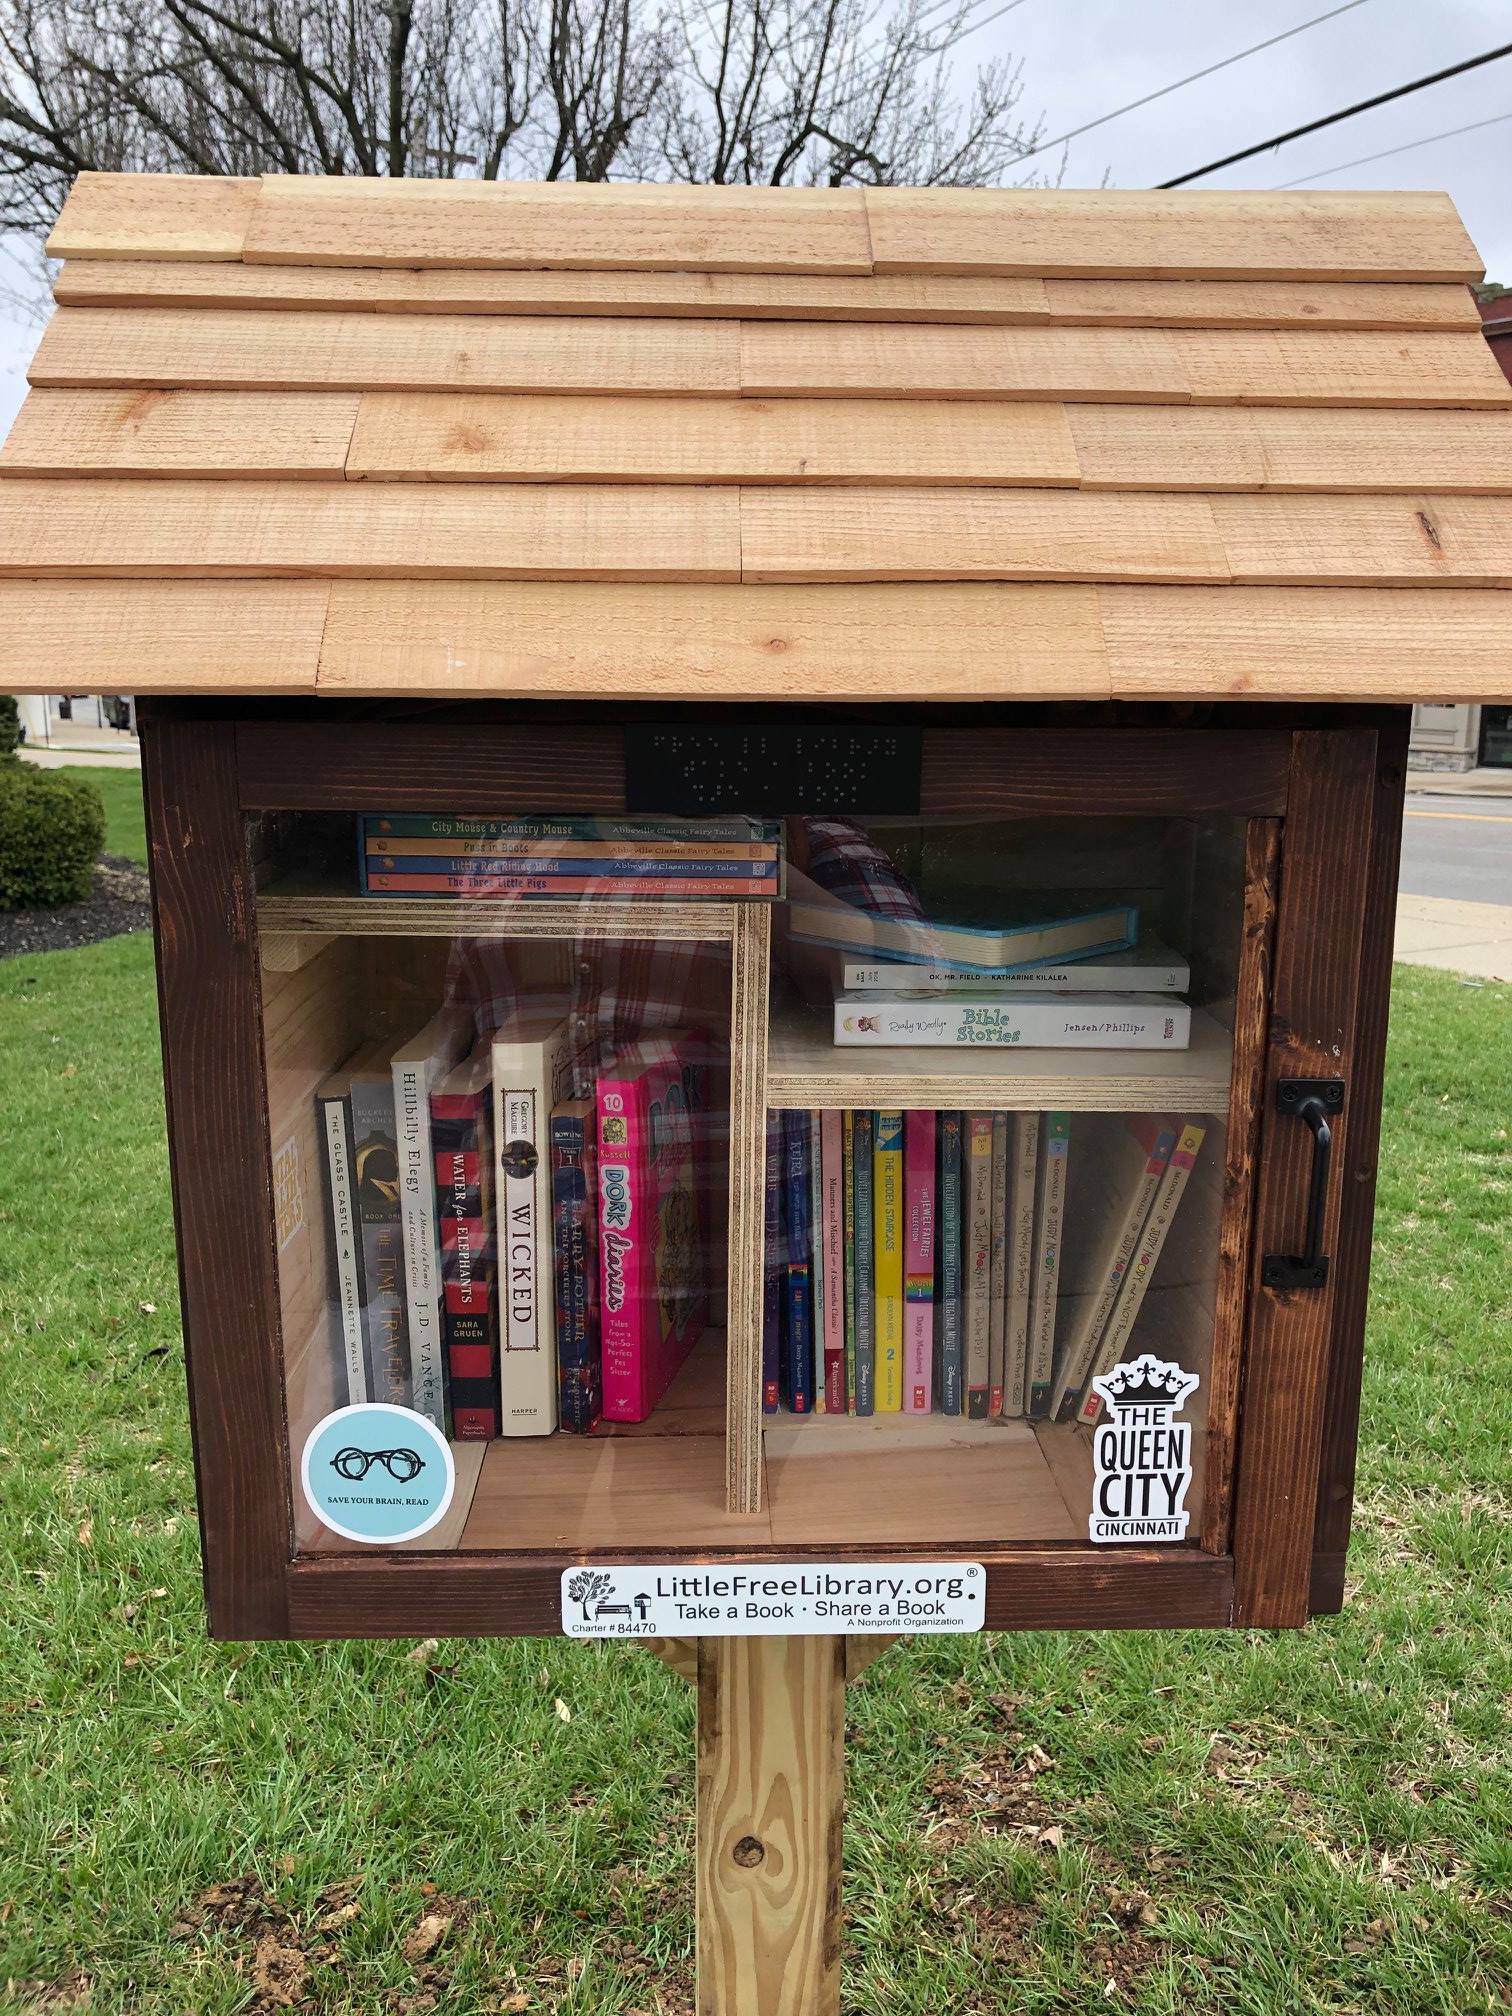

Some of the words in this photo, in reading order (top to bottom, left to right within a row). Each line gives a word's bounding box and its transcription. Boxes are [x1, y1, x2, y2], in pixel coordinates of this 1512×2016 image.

[432, 821, 451, 834] City
[456, 823, 486, 833] Mouse
[490, 823, 497, 833] &
[501, 823, 539, 835] Country
[543, 824, 573, 834] Mouse
[689, 828, 713, 837] Fairy
[714, 828, 737, 836] Tales
[481, 861, 498, 872] Red
[715, 864, 738, 872] Tales
[448, 877, 463, 887] The
[527, 879, 547, 890] Pigs
[991, 974, 1034, 982] KATHARINE
[963, 1008, 1010, 1026] Bible
[957, 1025, 1021, 1043] Stories
[404, 1072, 419, 1143] Hillbilly
[605, 1096, 622, 1109] 10
[331, 1115, 340, 1134] THE
[510, 1101, 519, 1135] MAGUIRE
[520, 1101, 529, 1135] GREGORY
[334, 1143, 344, 1182] GLASS
[406, 1150, 421, 1194] Elegy
[566, 1154, 573, 1164] 1
[790, 1141, 803, 1178] KEIRA
[885, 1157, 895, 1172] THE
[452, 1154, 467, 1200] WATER
[885, 1175, 895, 1205] HIDDEN
[1051, 1159, 1062, 1200] McDONALD
[605, 1169, 627, 1226] DORK
[829, 1178, 838, 1209] Manners
[858, 1170, 869, 1219] NOVELIZATION
[944, 1173, 956, 1221] NOVELIZATION
[1162, 1171, 1182, 1211] McDONALD
[338, 1190, 348, 1236] CASTLE
[452, 1203, 467, 1222] for
[560, 1199, 569, 1224] AND
[830, 1210, 838, 1224] and
[859, 1219, 869, 1227] OF
[920, 1199, 931, 1226] JEWEL
[420, 1218, 428, 1246] Memoir
[571, 1199, 584, 1268] HARRY
[859, 1229, 869, 1240] THE
[885, 1208, 895, 1252] STAIRCASE
[945, 1221, 956, 1230] OF
[945, 1232, 956, 1242] THE
[974, 1219, 987, 1241] Judy
[1047, 1218, 1057, 1240] JUDY
[1146, 1227, 1160, 1250] JUDY
[830, 1225, 839, 1255] Mischief
[920, 1228, 931, 1258] FAIRIES
[1120, 1234, 1135, 1257] JUDY
[457, 1227, 473, 1304] ELEPHANTS
[511, 1203, 532, 1323] WICKED
[604, 1233, 631, 1311] diaries
[376, 1254, 398, 1303] TIME
[422, 1263, 431, 1290] Family
[859, 1266, 870, 1294] CHANNEL
[945, 1268, 956, 1297] CHANNEL
[831, 1275, 840, 1306] Samantha
[917, 1288, 923, 1298] 1
[415, 1302, 430, 1334] J.D.
[573, 1276, 585, 1342] POTTER
[859, 1296, 870, 1327] ORIGINAL
[945, 1299, 956, 1329] ORIGINAL
[1120, 1305, 1133, 1325] NOT
[344, 1275, 356, 1334] JEANNETTE
[351, 1341, 359, 1374] WALLS
[454, 1330, 483, 1338] GRUEN
[456, 1321, 479, 1329] SARA
[860, 1329, 870, 1349] MOVIE
[946, 1331, 956, 1351] MOVIE
[886, 1348, 895, 1360] 2
[421, 1342, 434, 1400] VANCE
[947, 1365, 956, 1385] Disney
[1118, 1408, 1166, 1426] THE
[1100, 1429, 1184, 1473] QUEEN
[327, 1496, 350, 1504] SAVE
[350, 1497, 374, 1505] YOUR
[375, 1498, 404, 1506] BRAIN,
[405, 1498, 429, 1506] READ
[1099, 1473, 1185, 1517] CITY
[1096, 1521, 1179, 1536] CINCINNATI
[675, 1603, 720, 1619] Take
[727, 1606, 738, 1618] a
[746, 1602, 794, 1619] Book
[815, 1600, 872, 1616] Share
[878, 1603, 890, 1616] a
[897, 1600, 946, 1615] Book
[857, 1618, 901, 1627] Nonprofit
[904, 1617, 964, 1627] Organization
[572, 1623, 607, 1633] Charter
[617, 1623, 657, 1634] 84470
